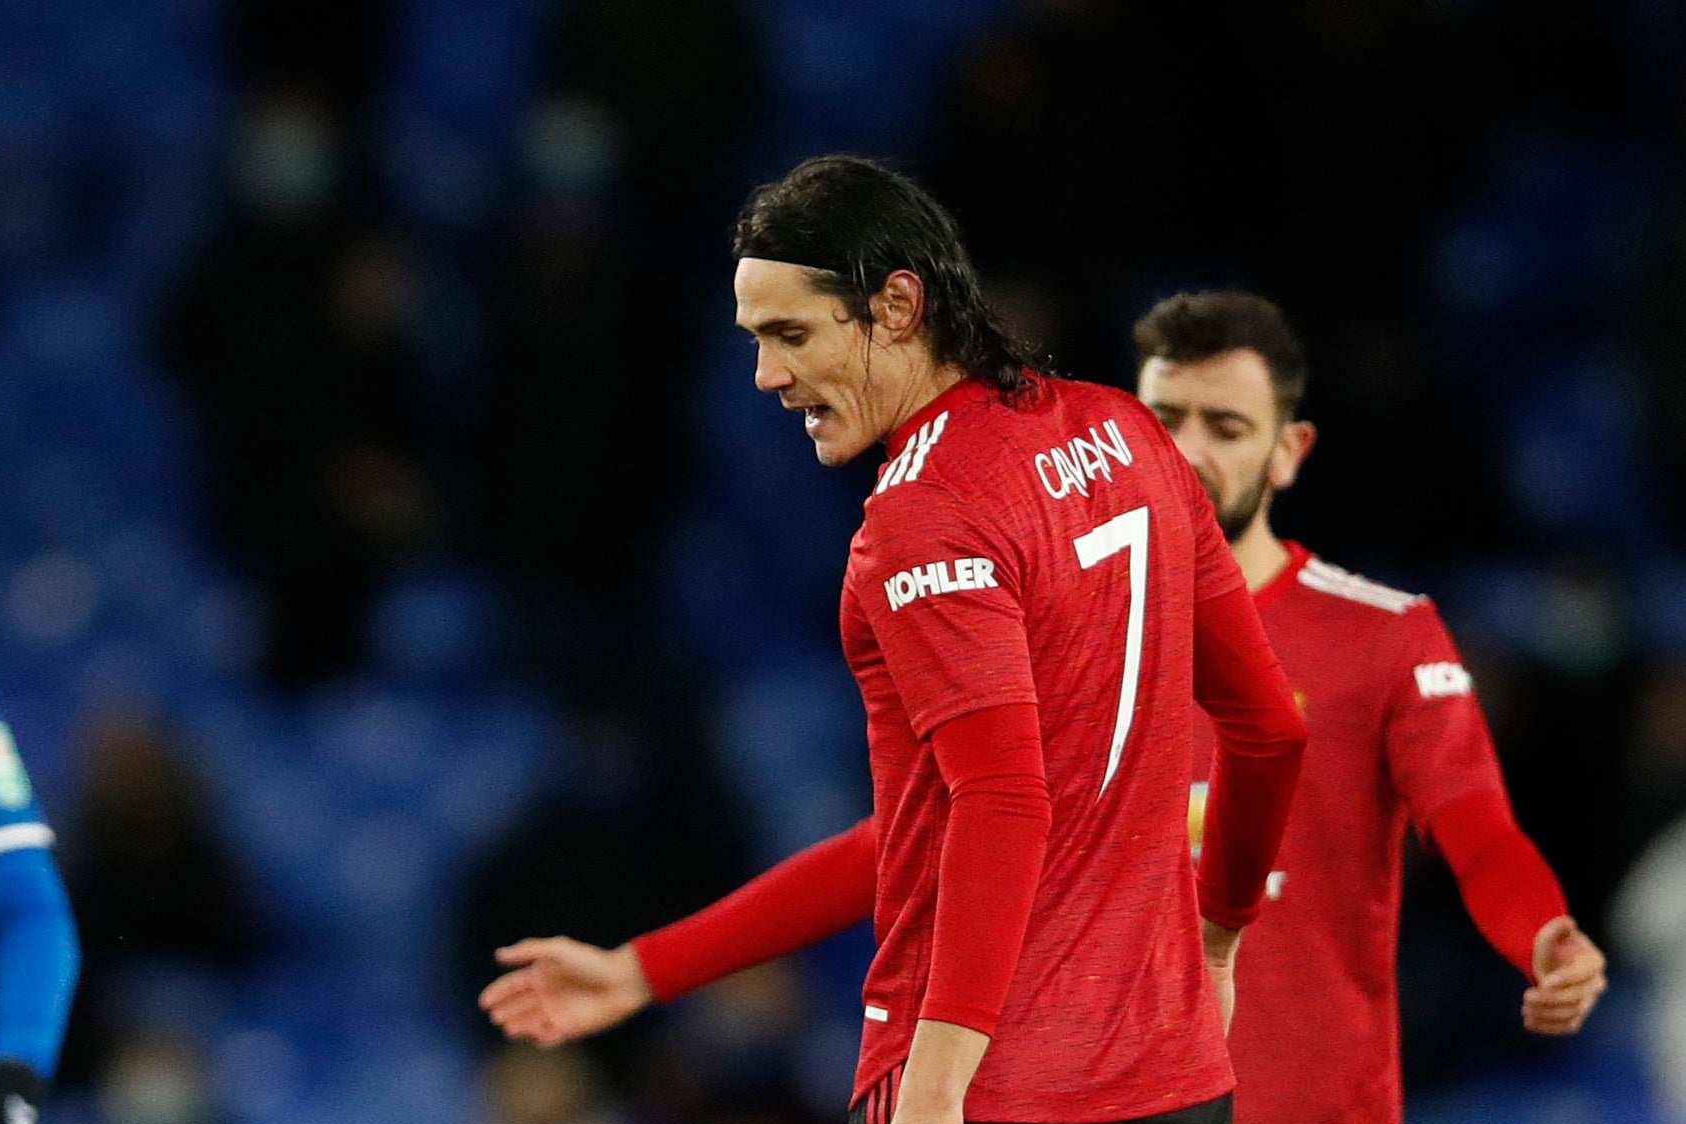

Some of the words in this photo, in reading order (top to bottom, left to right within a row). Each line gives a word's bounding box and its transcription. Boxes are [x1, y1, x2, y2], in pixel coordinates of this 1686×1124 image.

[1034, 418, 1133, 500] CAVANI
[883, 557, 999, 612] KOHLER
[1073, 505, 1149, 803] 7
